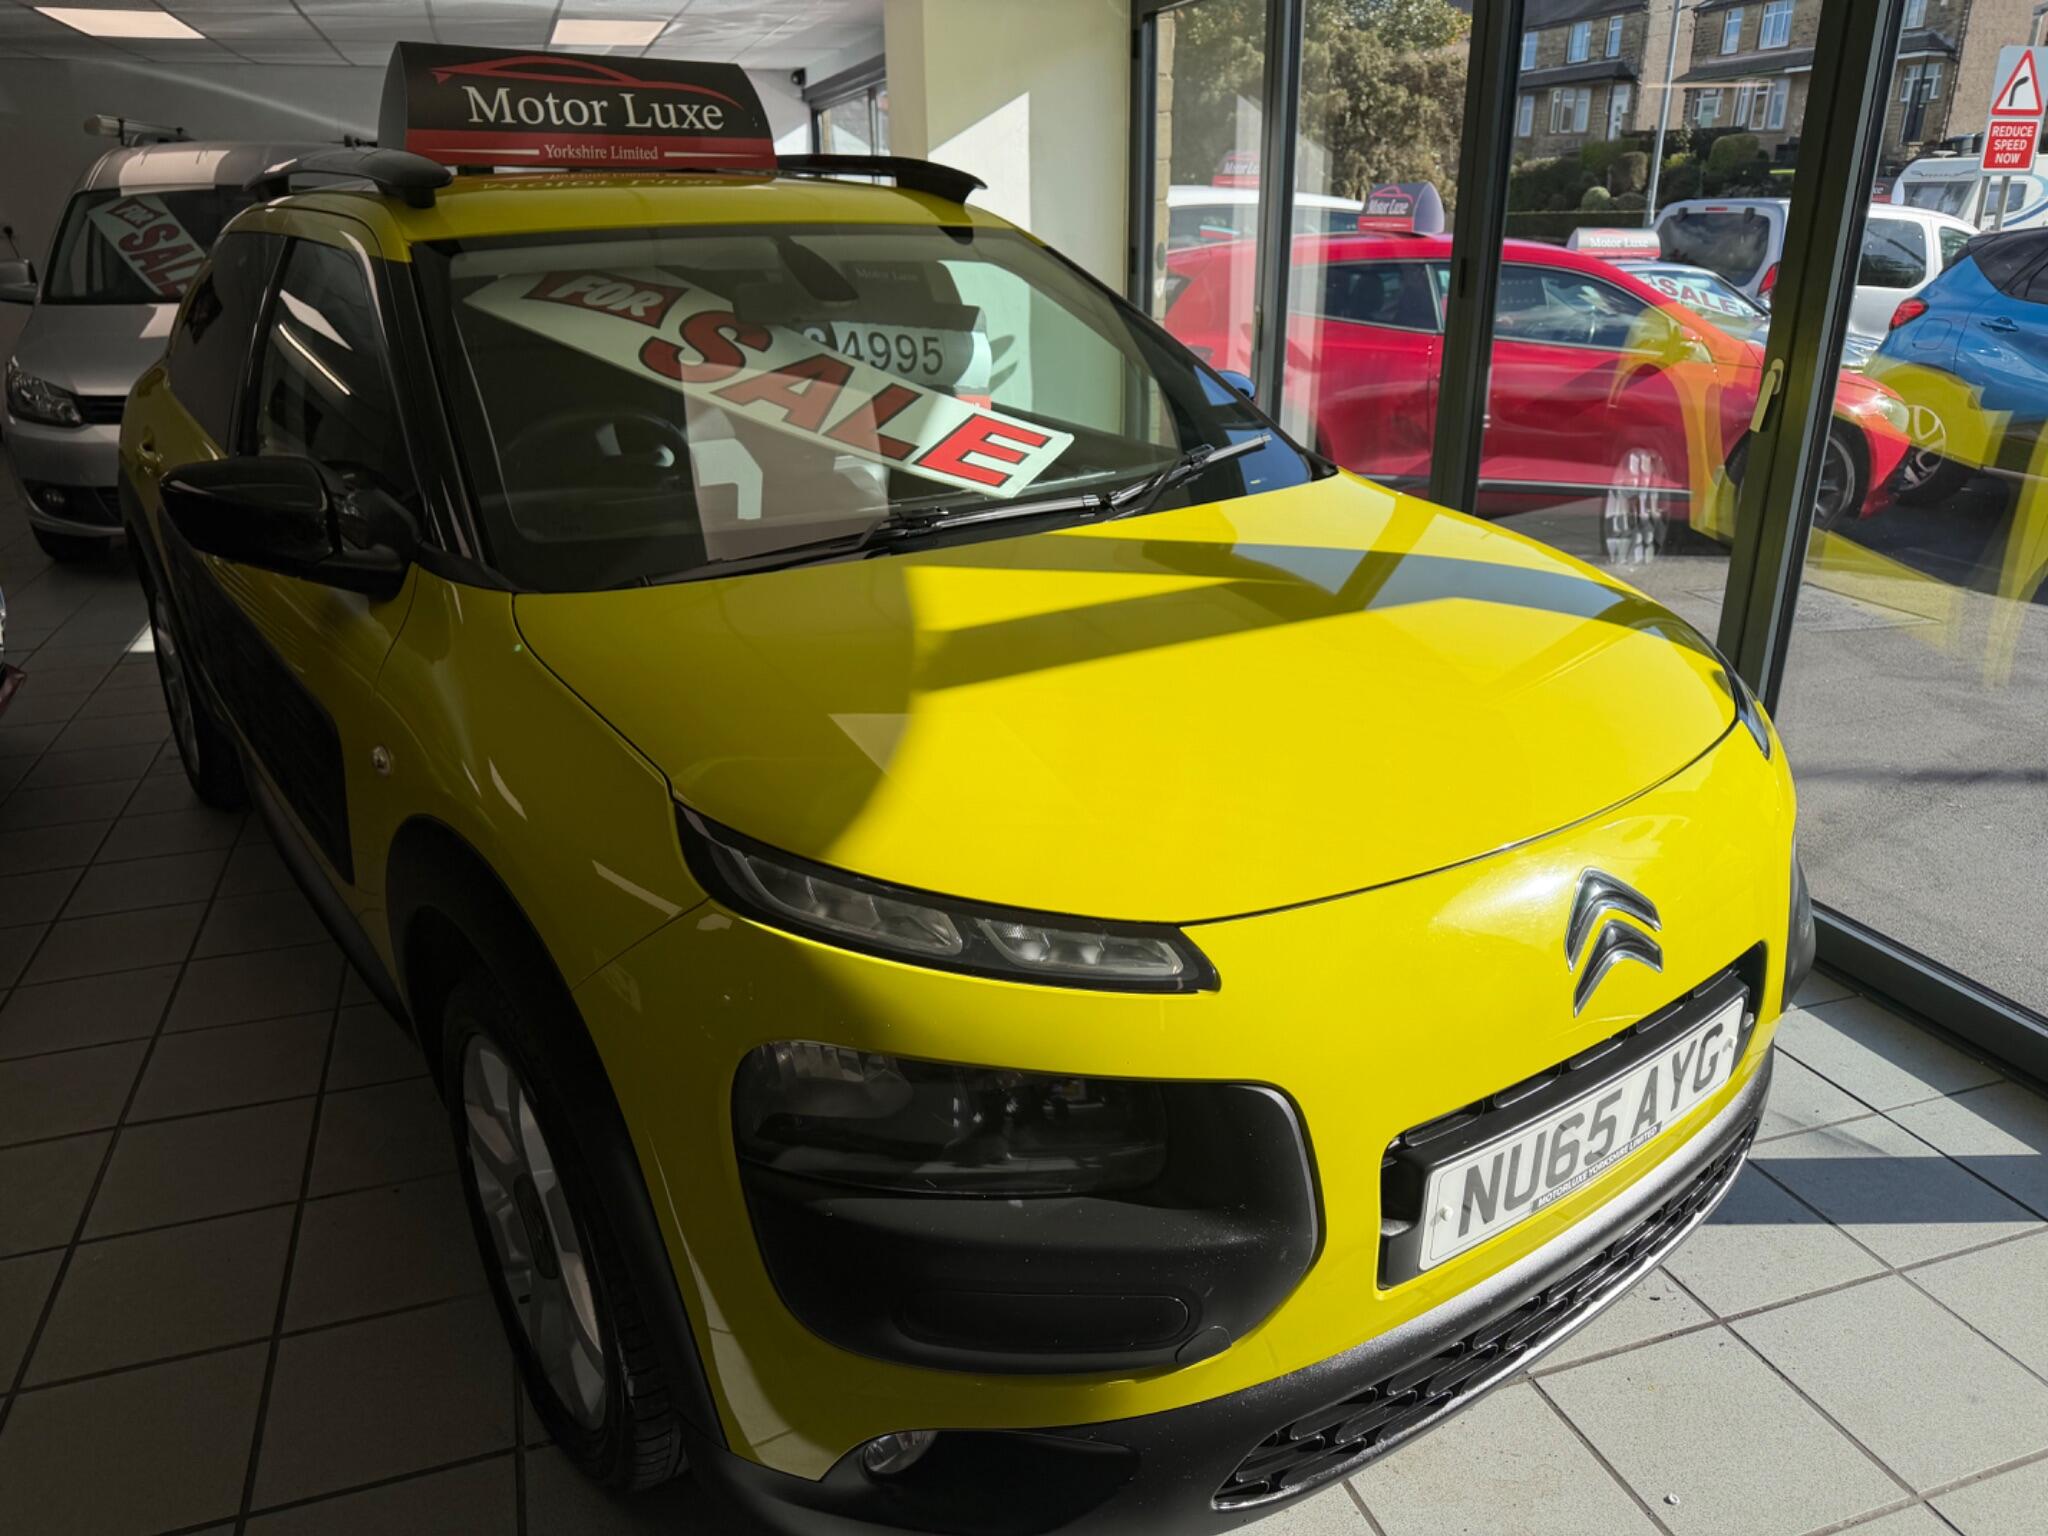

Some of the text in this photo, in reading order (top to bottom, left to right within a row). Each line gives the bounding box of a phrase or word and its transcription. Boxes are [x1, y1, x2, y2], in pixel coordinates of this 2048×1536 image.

[464, 86, 724, 130] Motor Luxe
[1991, 125, 2033, 137] REDUCE
[1993, 139, 2027, 150] SPEED
[544, 144, 659, 160] Yorkshire Limited
[1995, 153, 2021, 164] NOW
[553, 274, 662, 320] FOR
[1658, 277, 1738, 313] SALE
[638, 309, 1053, 488] SALE
[1457, 1022, 1724, 1239] NU65 AYG
[1629, 1126, 1658, 1151] LIMITED
